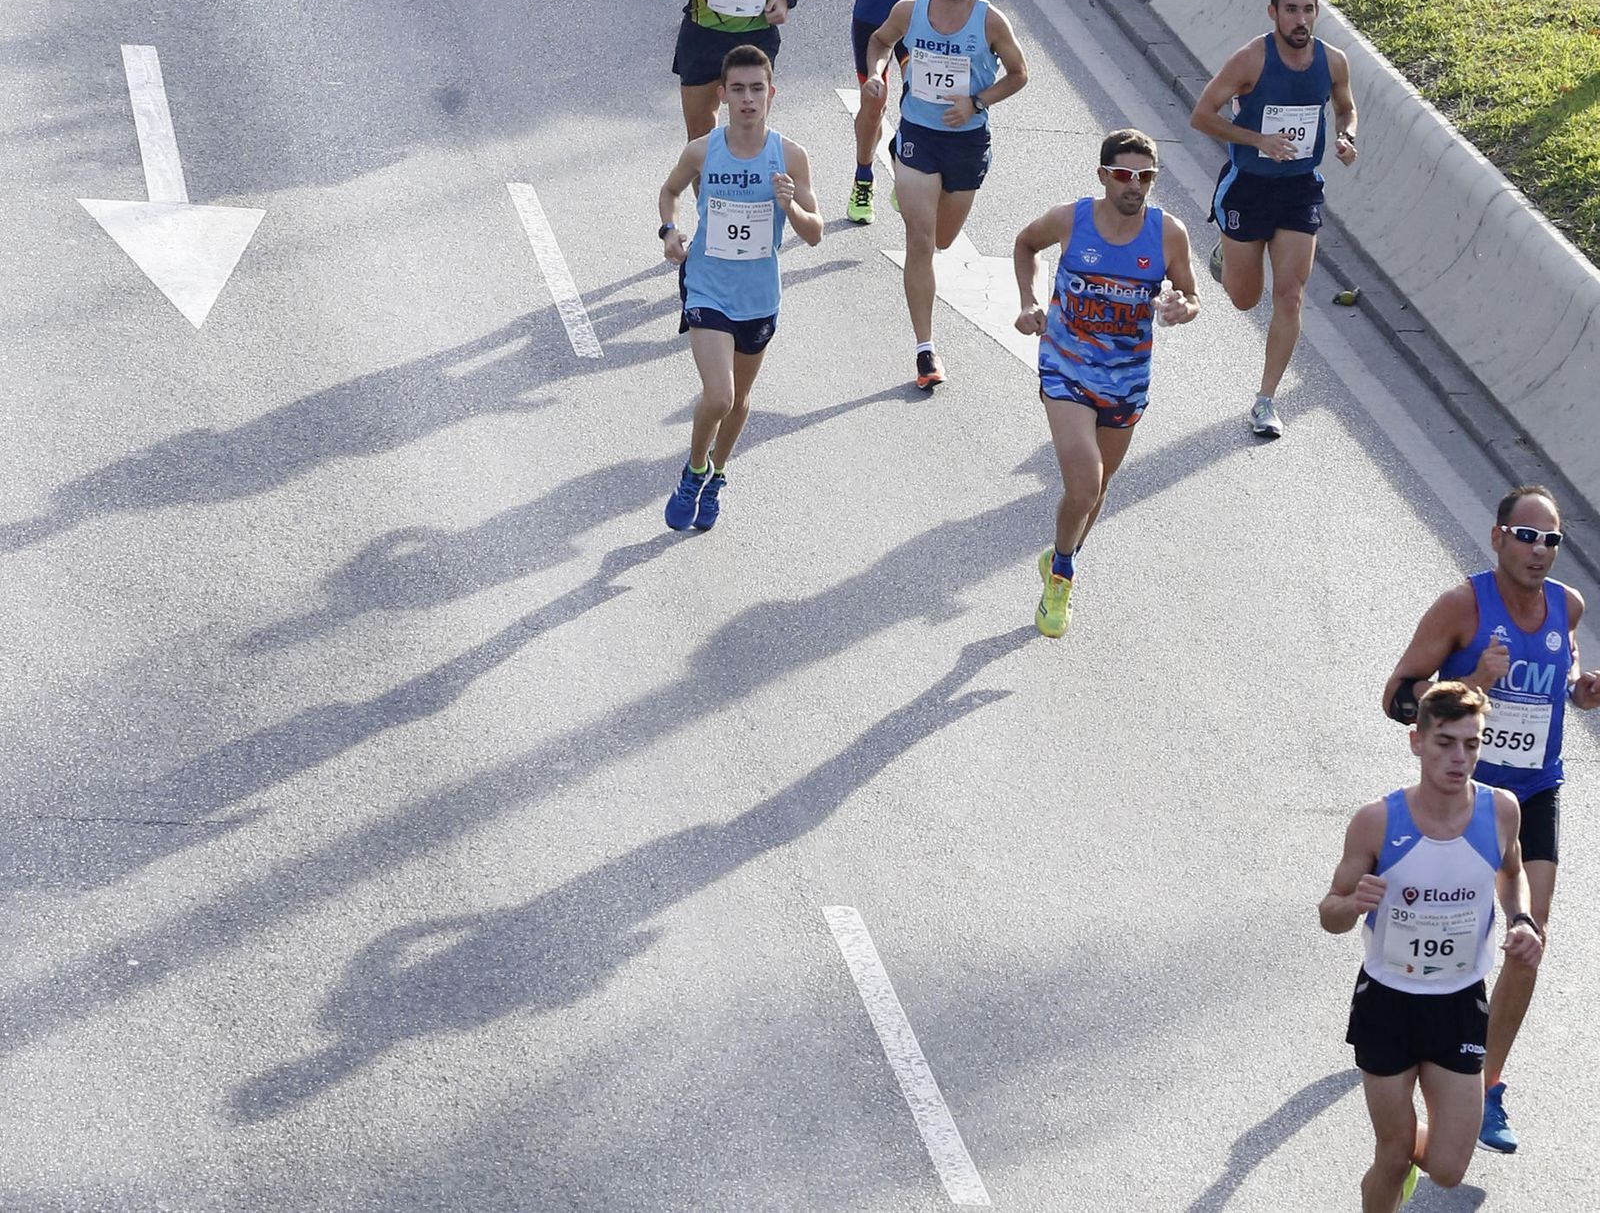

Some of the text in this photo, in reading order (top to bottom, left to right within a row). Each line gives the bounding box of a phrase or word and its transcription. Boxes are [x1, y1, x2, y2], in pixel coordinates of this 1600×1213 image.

[915, 38, 962, 55] nerja
[925, 72, 954, 88] 175
[708, 170, 762, 189] nerja
[727, 224, 750, 240] 95
[1482, 727, 1535, 751] 6559
[1424, 888, 1476, 902] Eladio
[1409, 939, 1455, 957] 196
